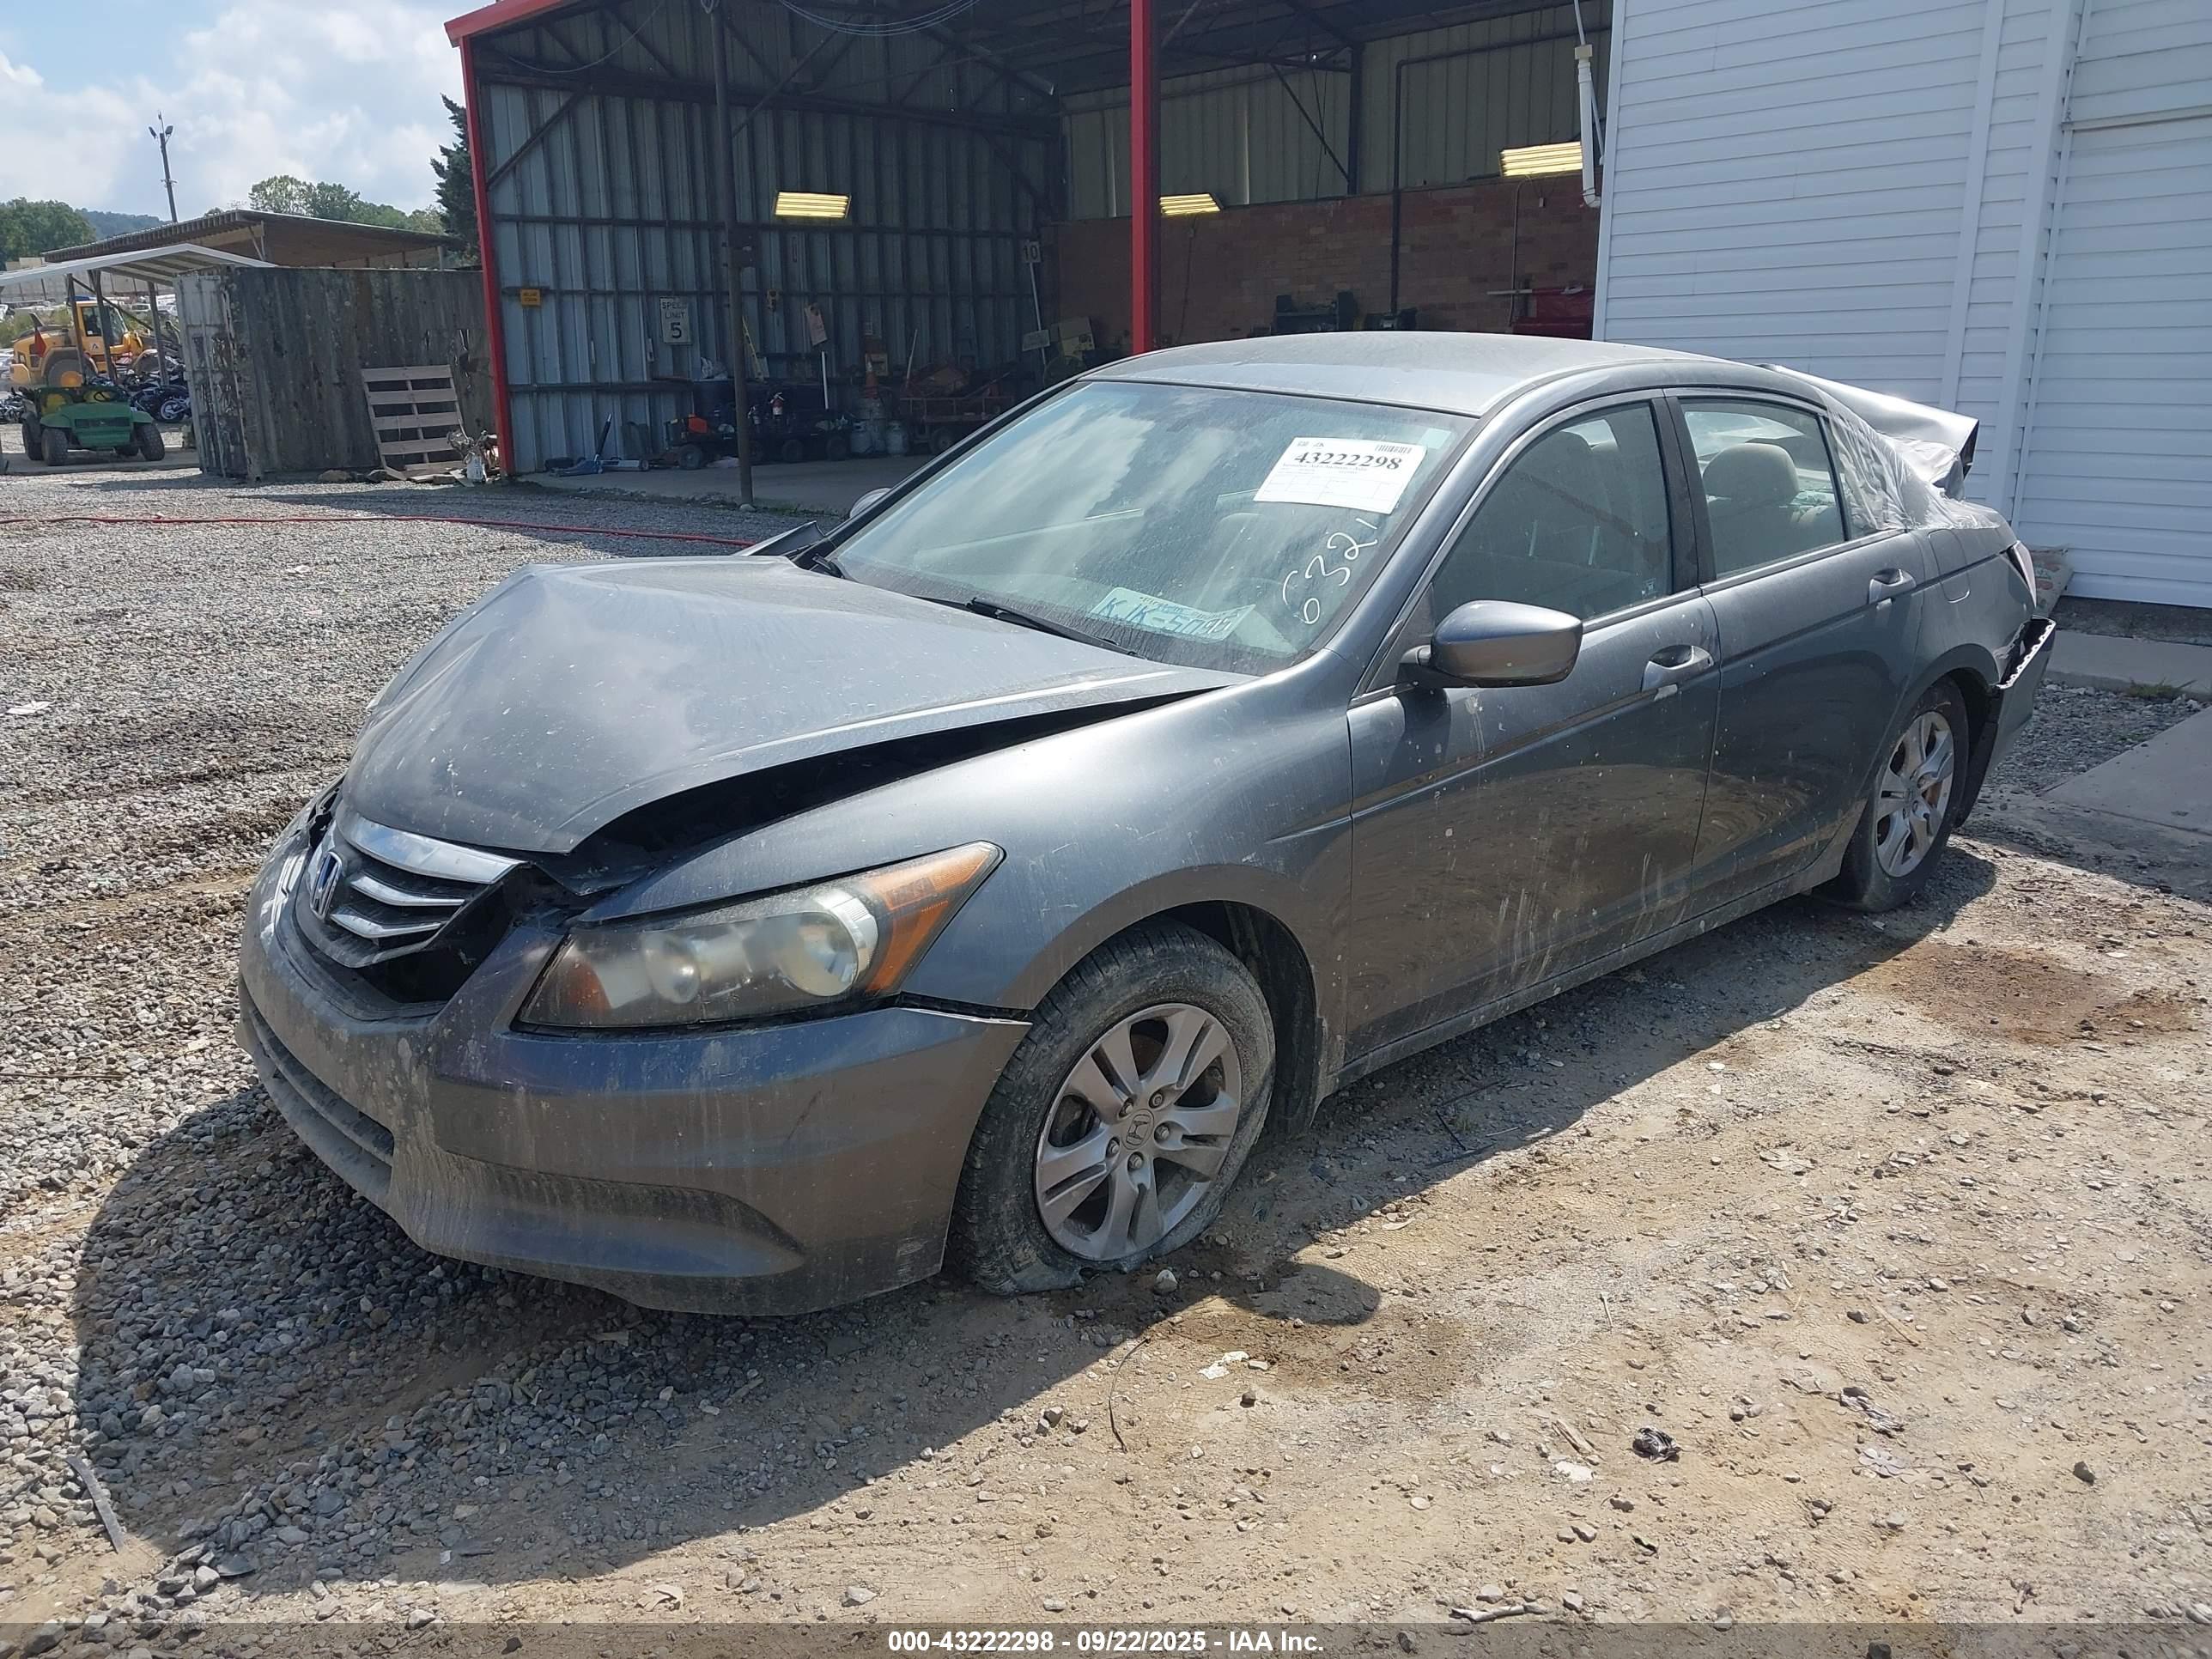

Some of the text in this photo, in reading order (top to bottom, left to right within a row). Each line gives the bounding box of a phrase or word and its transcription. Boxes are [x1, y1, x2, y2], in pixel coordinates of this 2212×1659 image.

[1023, 245, 1038, 261] 10
[671, 321, 682, 339] 5
[1294, 451, 1402, 471] 43222298
